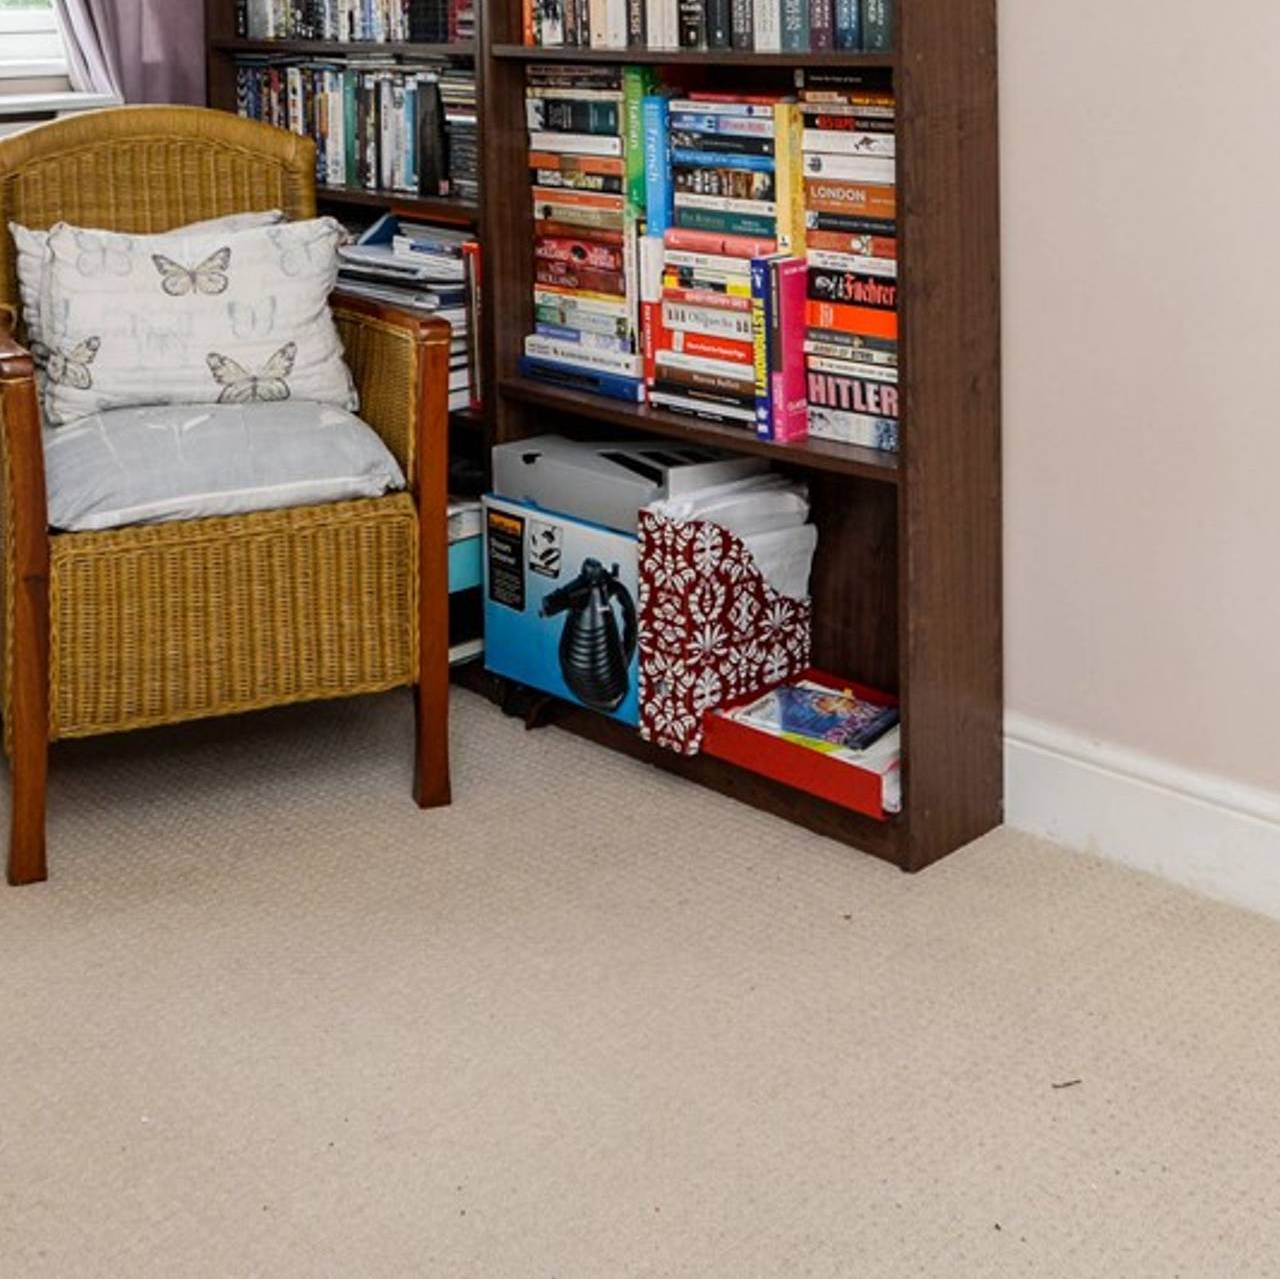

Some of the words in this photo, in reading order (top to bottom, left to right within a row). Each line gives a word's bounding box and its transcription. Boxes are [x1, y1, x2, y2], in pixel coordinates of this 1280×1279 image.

[647, 128, 660, 183] French
[810, 185, 867, 201] LONDON
[808, 372, 899, 417] HITLER
